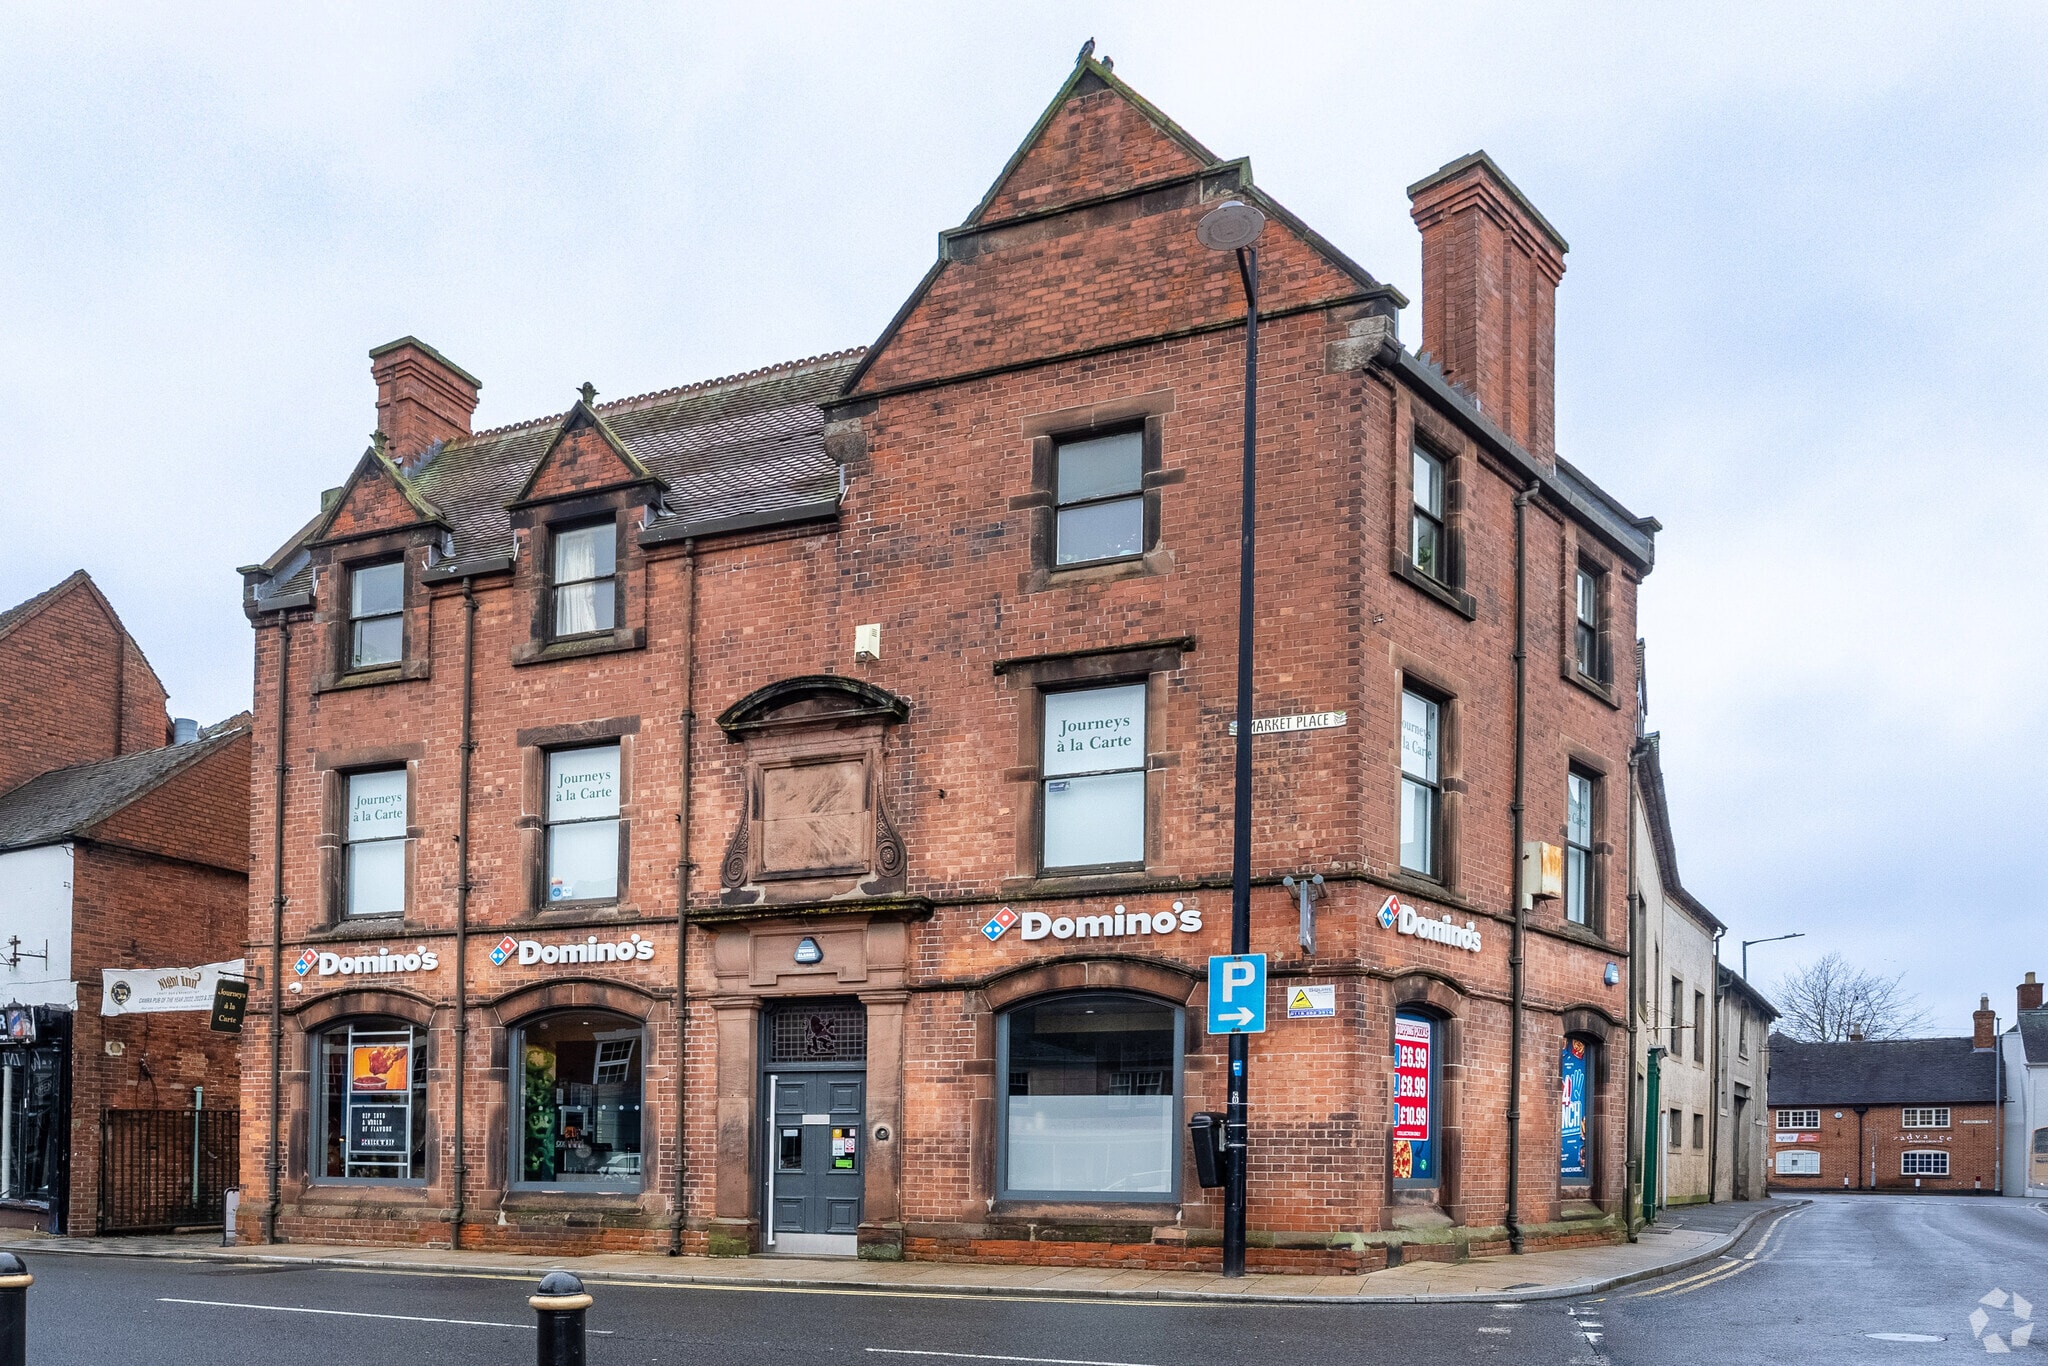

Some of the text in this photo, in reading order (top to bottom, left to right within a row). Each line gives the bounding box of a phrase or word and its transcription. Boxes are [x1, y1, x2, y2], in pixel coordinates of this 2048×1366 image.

[1059, 717, 1130, 737] Journeys
[1296, 714, 1329, 728] PLACE
[1402, 719, 1432, 741] ourneys
[1057, 735, 1132, 752] à la Carte
[557, 771, 611, 788] Journeys
[354, 795, 402, 810] Journeys
[556, 787, 612, 802] à la Carte
[353, 809, 403, 822] à la Carte
[1021, 901, 1203, 941] Domino's
[1397, 904, 1482, 953] Domino's
[518, 933, 655, 965] Domino's
[318, 945, 439, 976] Domino's
[157, 972, 202, 990] Night Inn
[1222, 961, 1256, 1003] P
[217, 988, 246, 999] Journeys
[229, 1002, 236, 1010] la
[218, 1014, 237, 1024] Carte
[1401, 1045, 1427, 1069] £6.99
[1401, 1075, 1426, 1098] £8.99
[1400, 1106, 1426, 1126] £10.99
